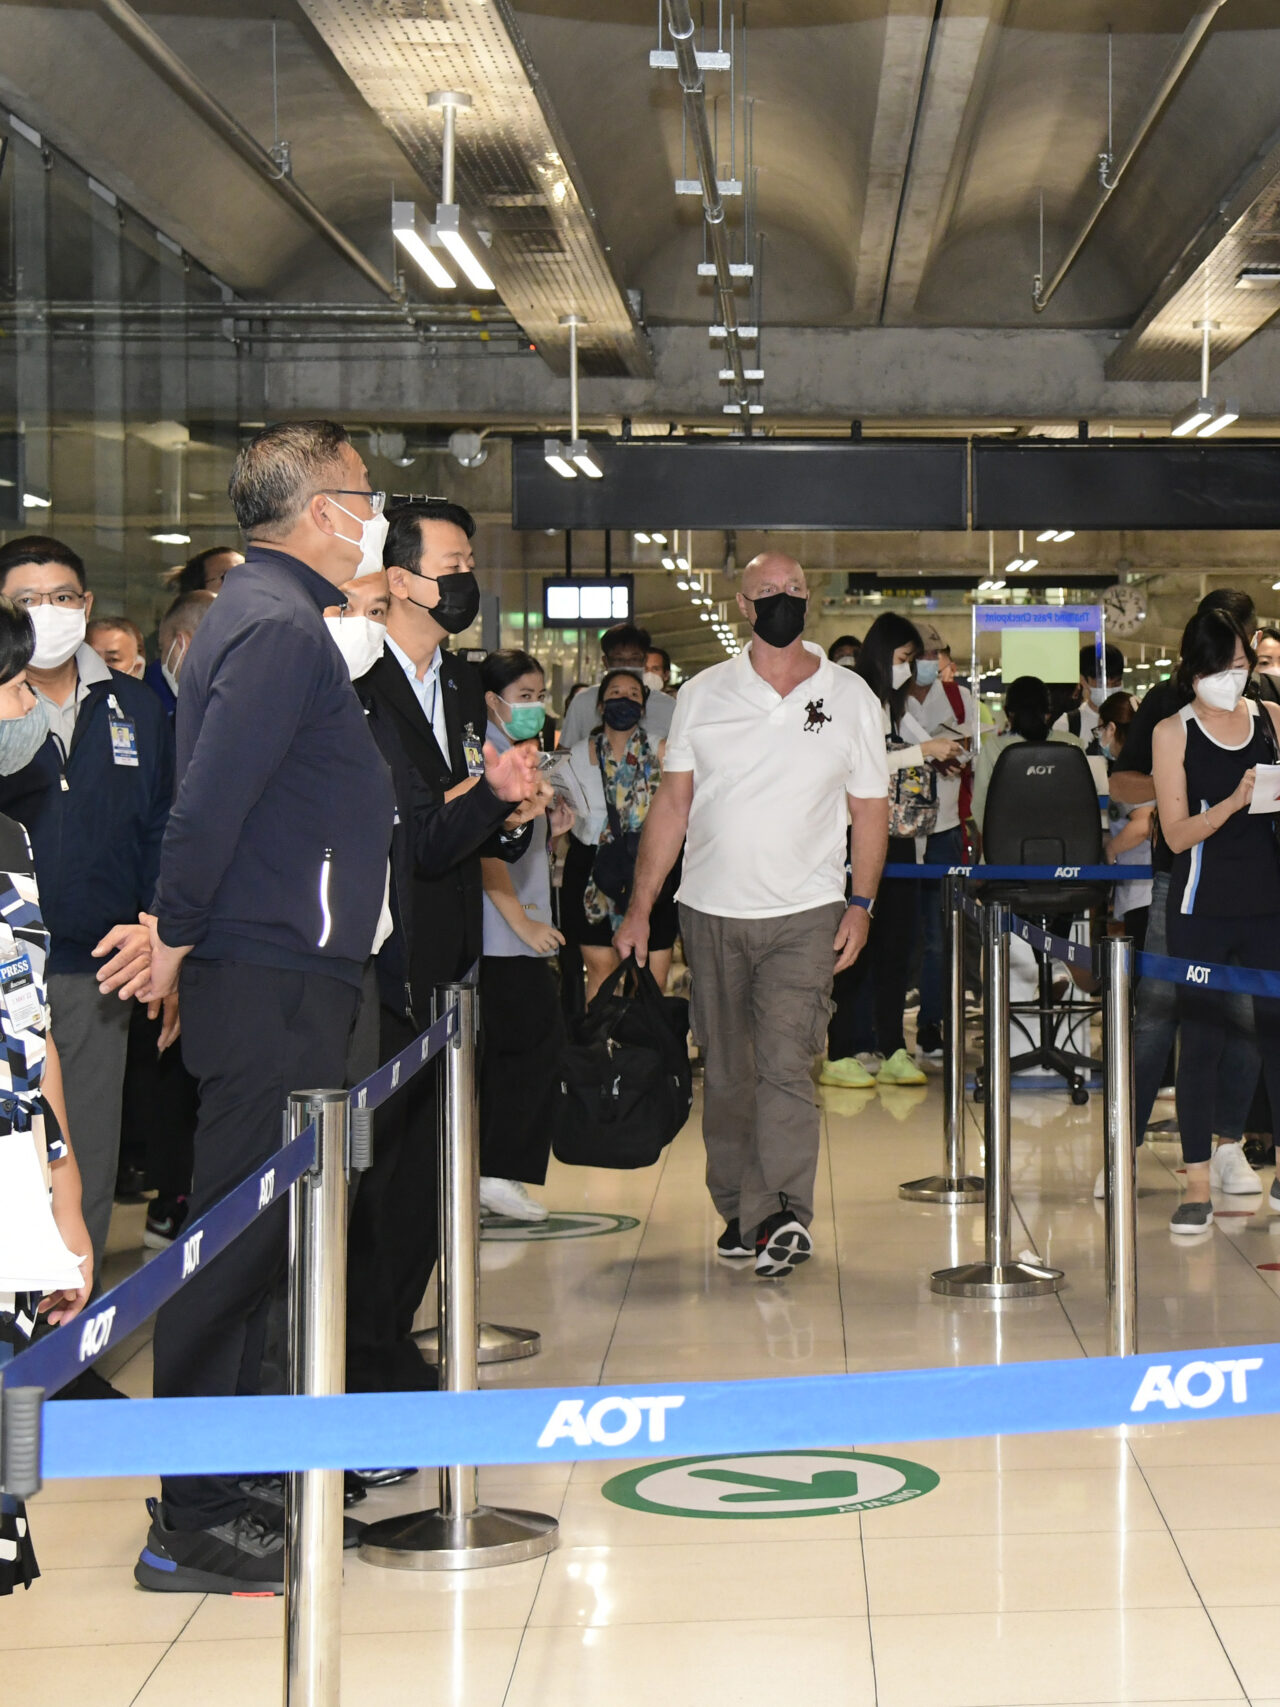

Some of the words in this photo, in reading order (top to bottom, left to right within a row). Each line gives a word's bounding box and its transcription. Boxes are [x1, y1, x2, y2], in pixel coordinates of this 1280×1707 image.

[1026, 765, 1055, 776] AOT
[947, 866, 973, 878] AOT
[1054, 866, 1081, 879] AOT
[0, 959, 30, 980] PRESS
[1186, 964, 1211, 984] AOT
[258, 1168, 276, 1210] AOT
[181, 1229, 205, 1280] AOT
[79, 1305, 117, 1363] AOT
[536, 1394, 686, 1449] AOT
[1129, 1357, 1264, 1413] AOT
[837, 1500, 890, 1513] WAY
